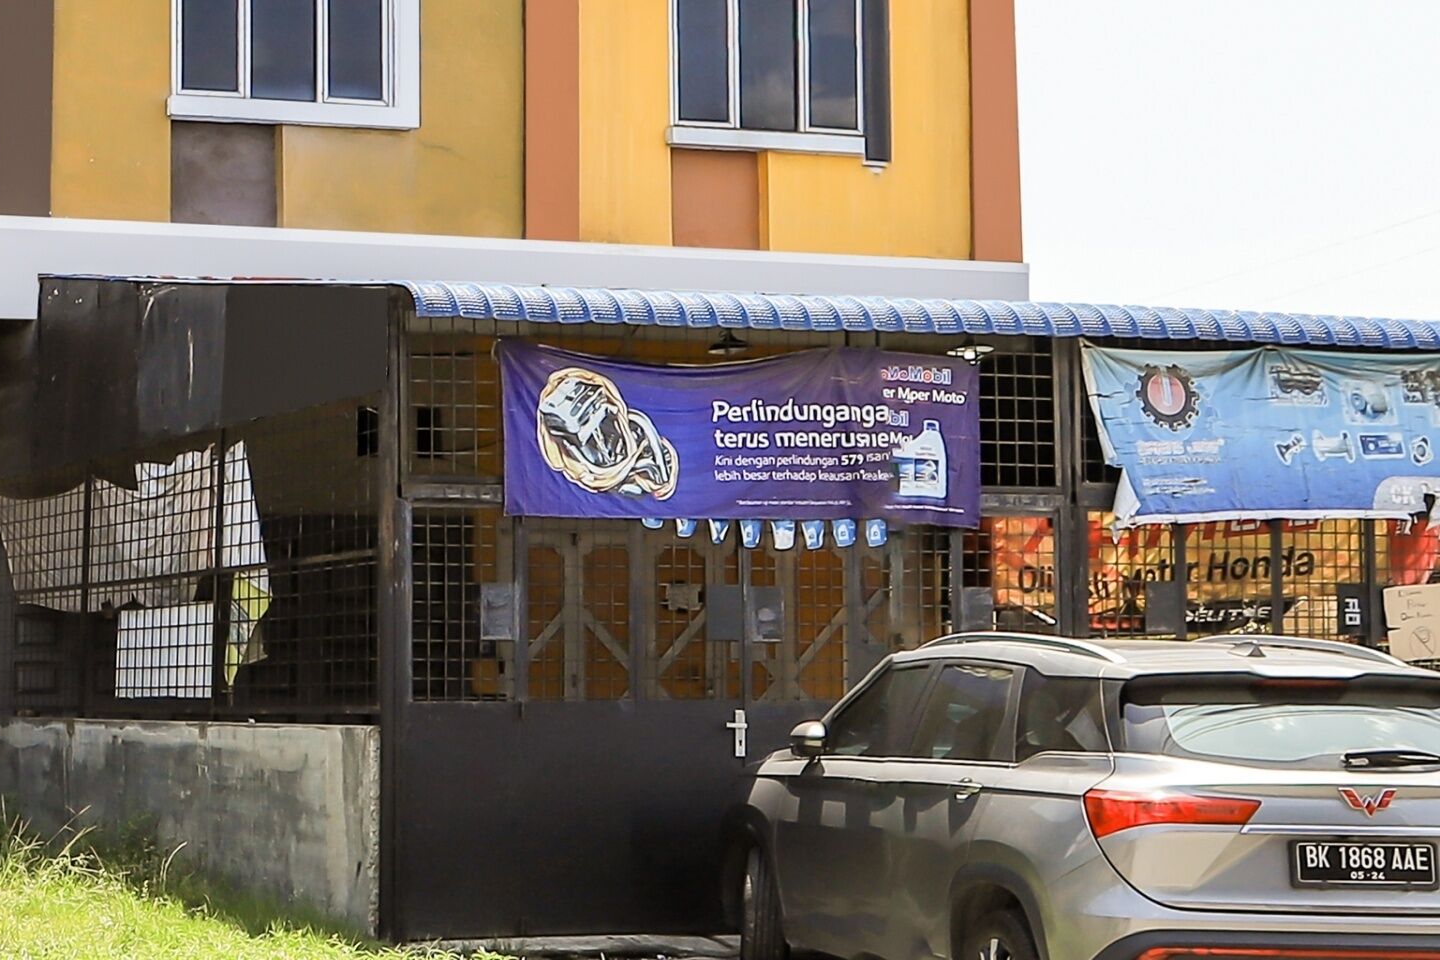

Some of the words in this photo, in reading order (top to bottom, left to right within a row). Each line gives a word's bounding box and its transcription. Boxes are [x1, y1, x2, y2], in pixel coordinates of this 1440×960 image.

[714, 429, 769, 449] terus
[715, 454, 732, 466] Kini
[735, 454, 775, 468] dengan
[777, 454, 838, 469] perlindungan
[714, 469, 741, 481] lebih
[743, 469, 771, 481] besar
[772, 469, 816, 483] terhadap
[1207, 546, 1315, 581] Honda
[1306, 845, 1330, 868] BK
[1339, 846, 1386, 869] 1868
[1391, 847, 1429, 870] AAE
